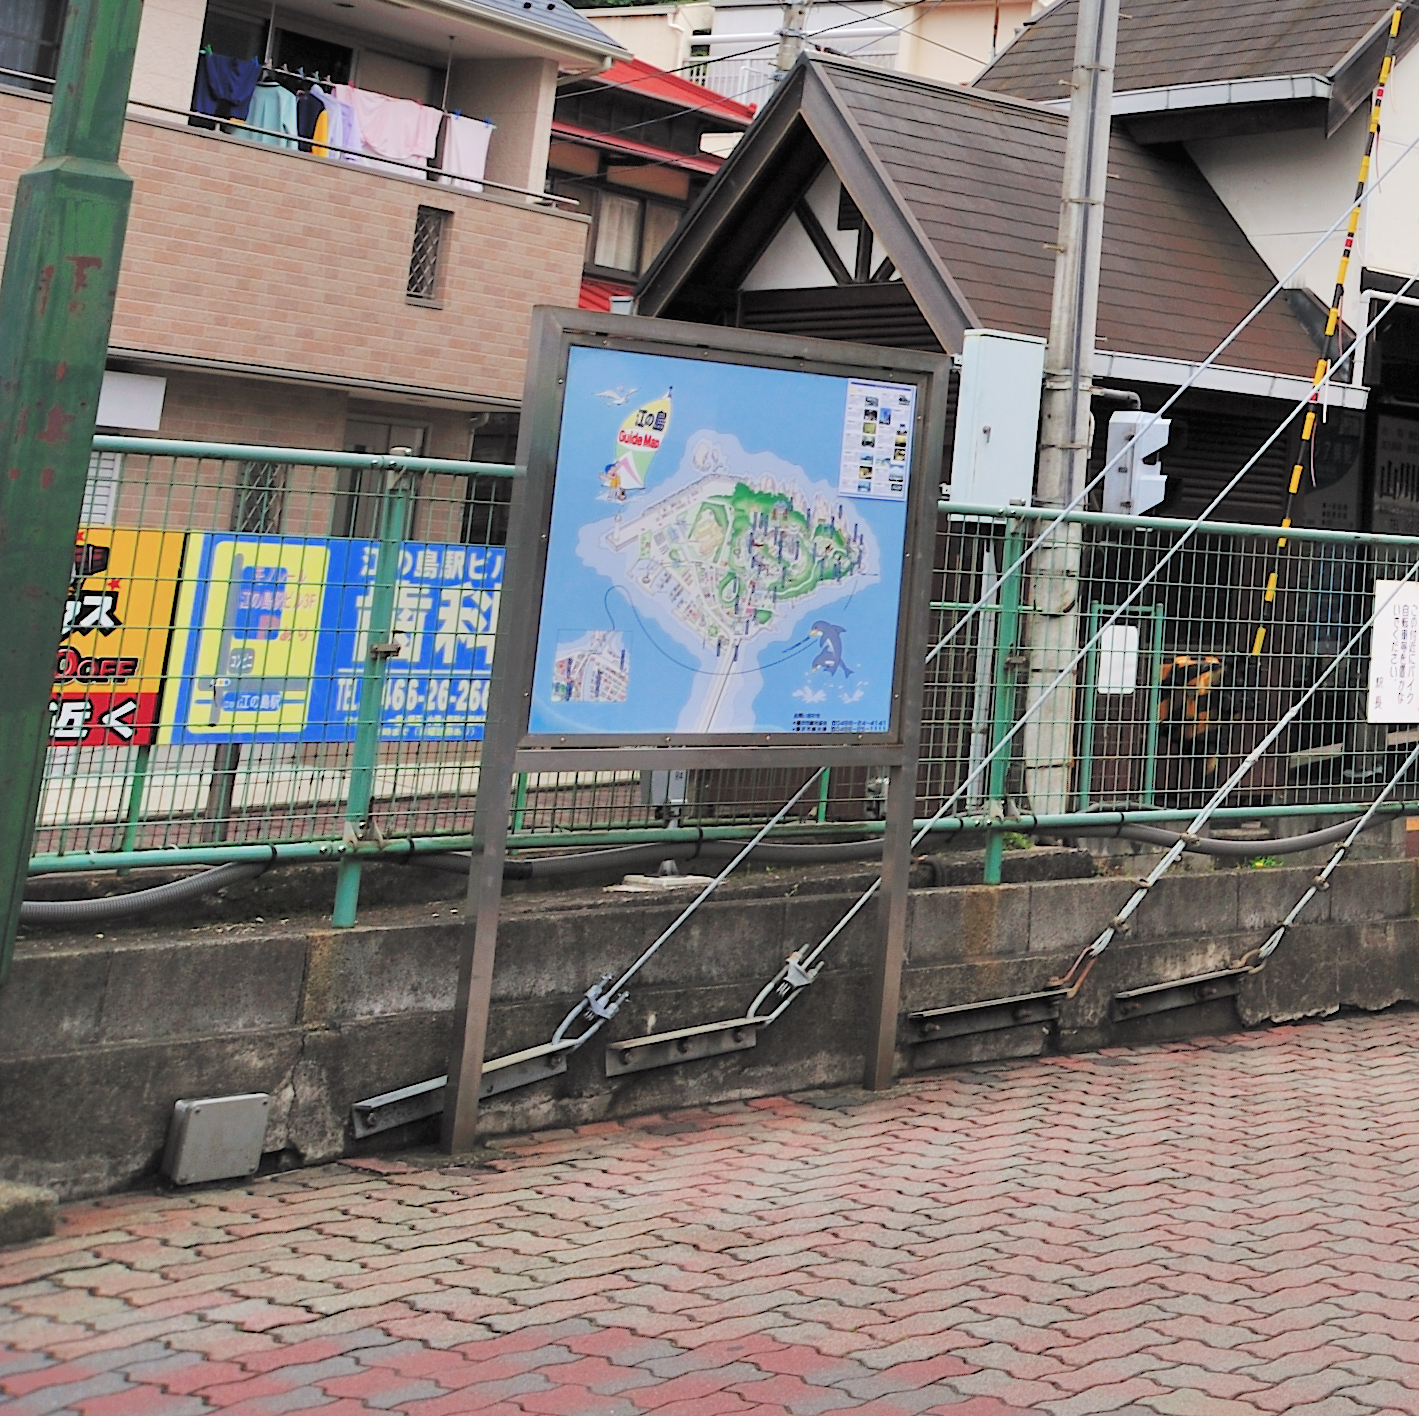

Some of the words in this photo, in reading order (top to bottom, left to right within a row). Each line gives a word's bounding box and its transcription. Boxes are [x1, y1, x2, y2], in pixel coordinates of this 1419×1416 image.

[618, 429, 643, 446] Guide
[643, 433, 660, 449] Map
[360, 545, 504, 580] 江の島駅ビ
